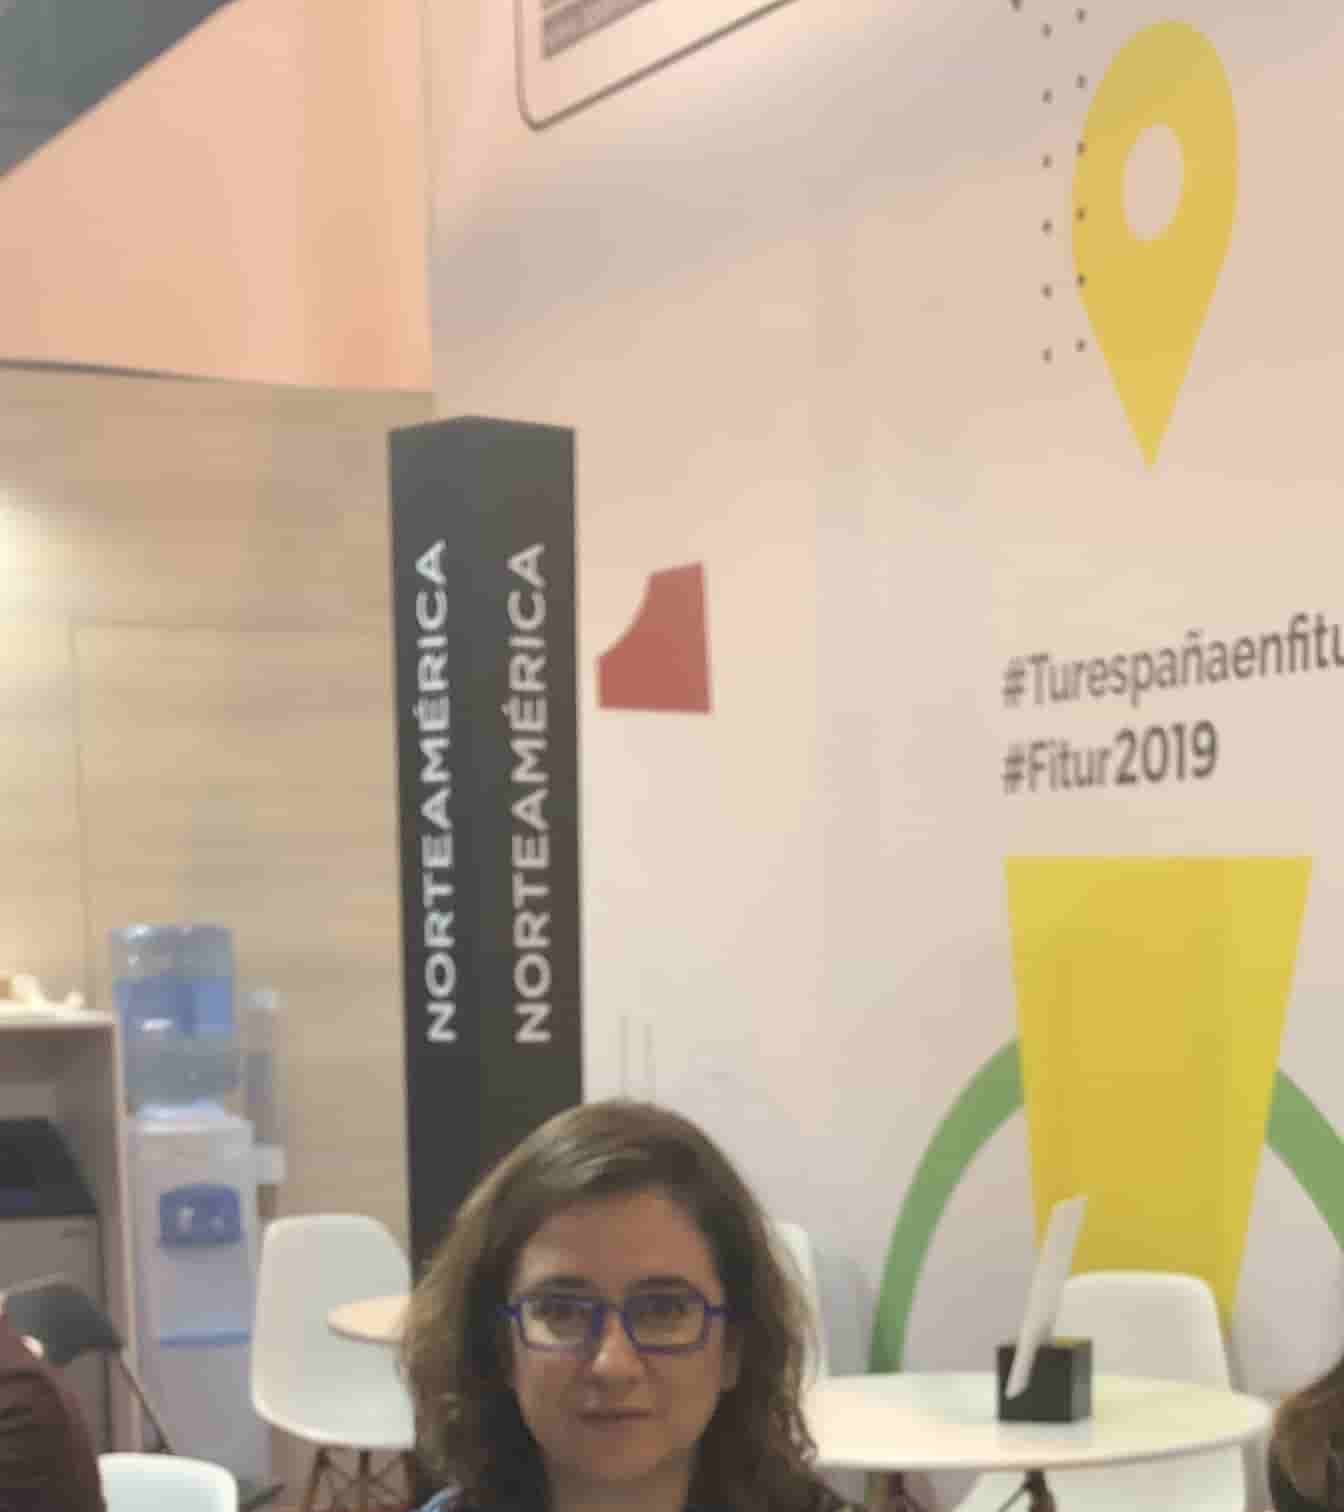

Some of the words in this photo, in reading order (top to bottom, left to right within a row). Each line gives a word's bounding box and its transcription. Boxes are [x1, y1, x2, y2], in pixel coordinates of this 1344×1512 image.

[413, 538, 457, 1044] NORTEAMÉRICA
[502, 542, 552, 1043] NORTEAMÉRICA
[1002, 719, 1219, 795] #Fitur2019
